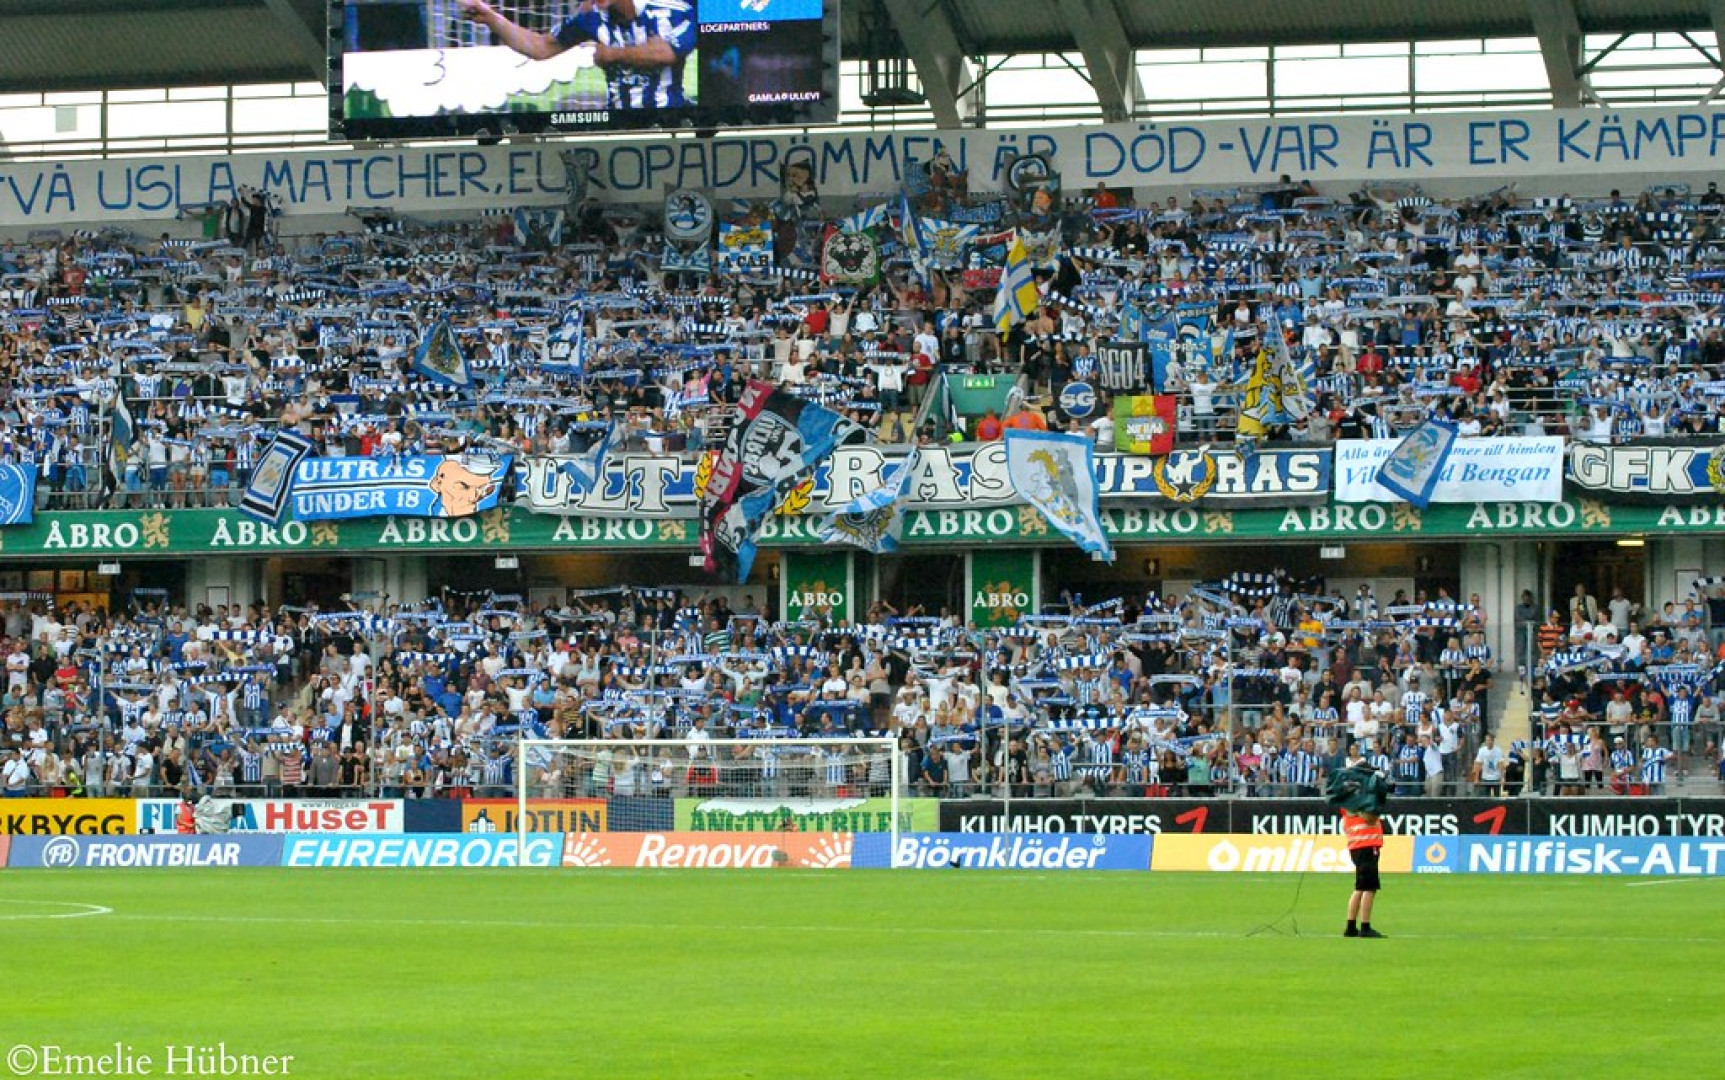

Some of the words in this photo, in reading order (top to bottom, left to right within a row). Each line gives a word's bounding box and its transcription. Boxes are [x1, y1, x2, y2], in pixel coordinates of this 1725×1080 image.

[551, 112, 610, 125] SAMSUNG
[0, 163, 76, 215] VÅ
[98, 161, 238, 211] USLA
[1366, 119, 1434, 169] ÄR
[1468, 119, 1531, 164] ER
[1342, 447, 1368, 459] Alla
[1484, 444, 1504, 456] till
[1507, 443, 1555, 455] himlen
[299, 459, 426, 481] ULTRAS
[1461, 463, 1551, 487] Bengan
[1573, 447, 1695, 491] GFK
[297, 491, 386, 515] UNDER
[396, 490, 420, 509] 18
[44, 519, 139, 549] ÅBRO
[0, 814, 125, 834] KBYGG
[266, 802, 395, 830] HuseT
[961, 814, 1065, 834] KUMHO
[1071, 814, 1162, 834] TYRES
[1380, 814, 1459, 836] YRES
[1551, 814, 1660, 836] KUMHO
[86, 843, 241, 866] FRONTBILAR
[287, 838, 556, 867] EHRENBORG
[635, 834, 778, 868] Renova
[1243, 839, 1357, 872] miles
